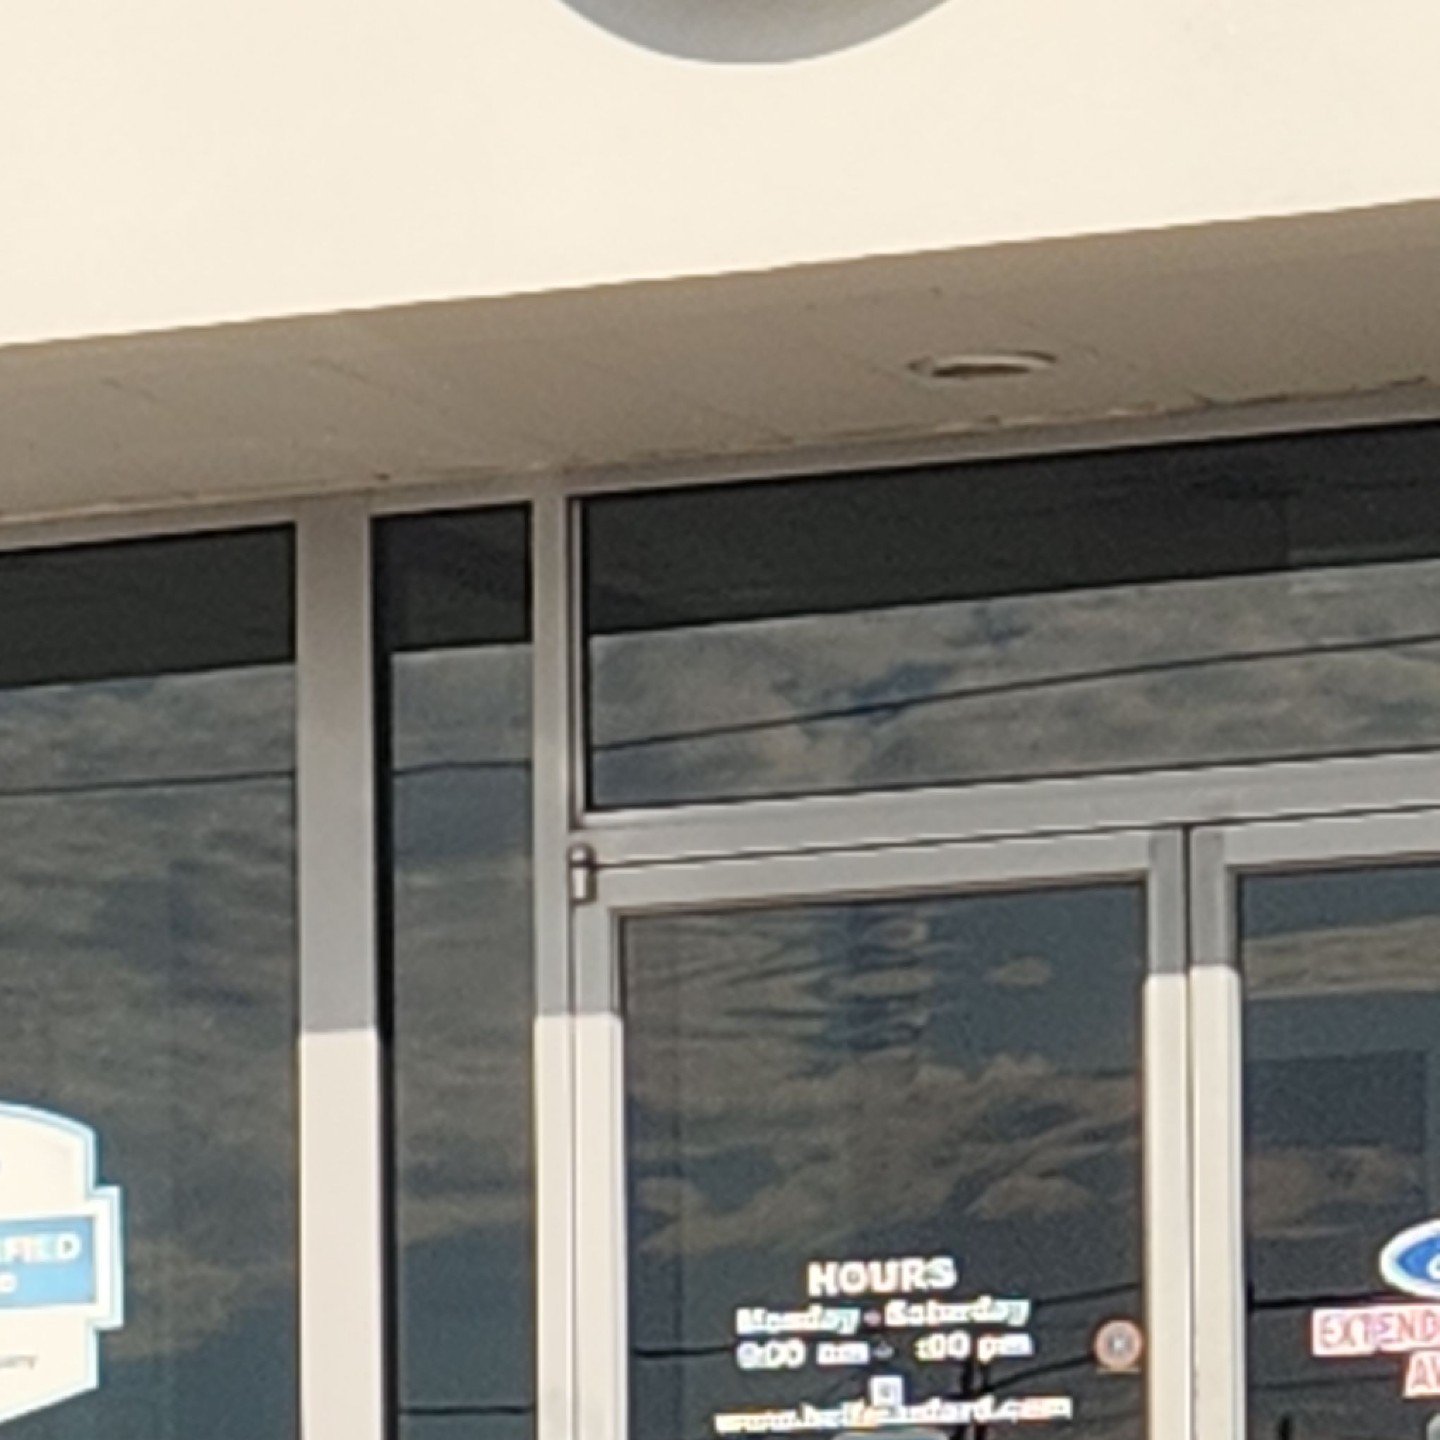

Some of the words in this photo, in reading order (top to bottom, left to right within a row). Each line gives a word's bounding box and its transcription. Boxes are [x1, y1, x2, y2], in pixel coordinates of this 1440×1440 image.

[807, 1257, 957, 1296] HOURS
[736, 1304, 861, 1334] Monday
[884, 1296, 1030, 1327] Saturday
